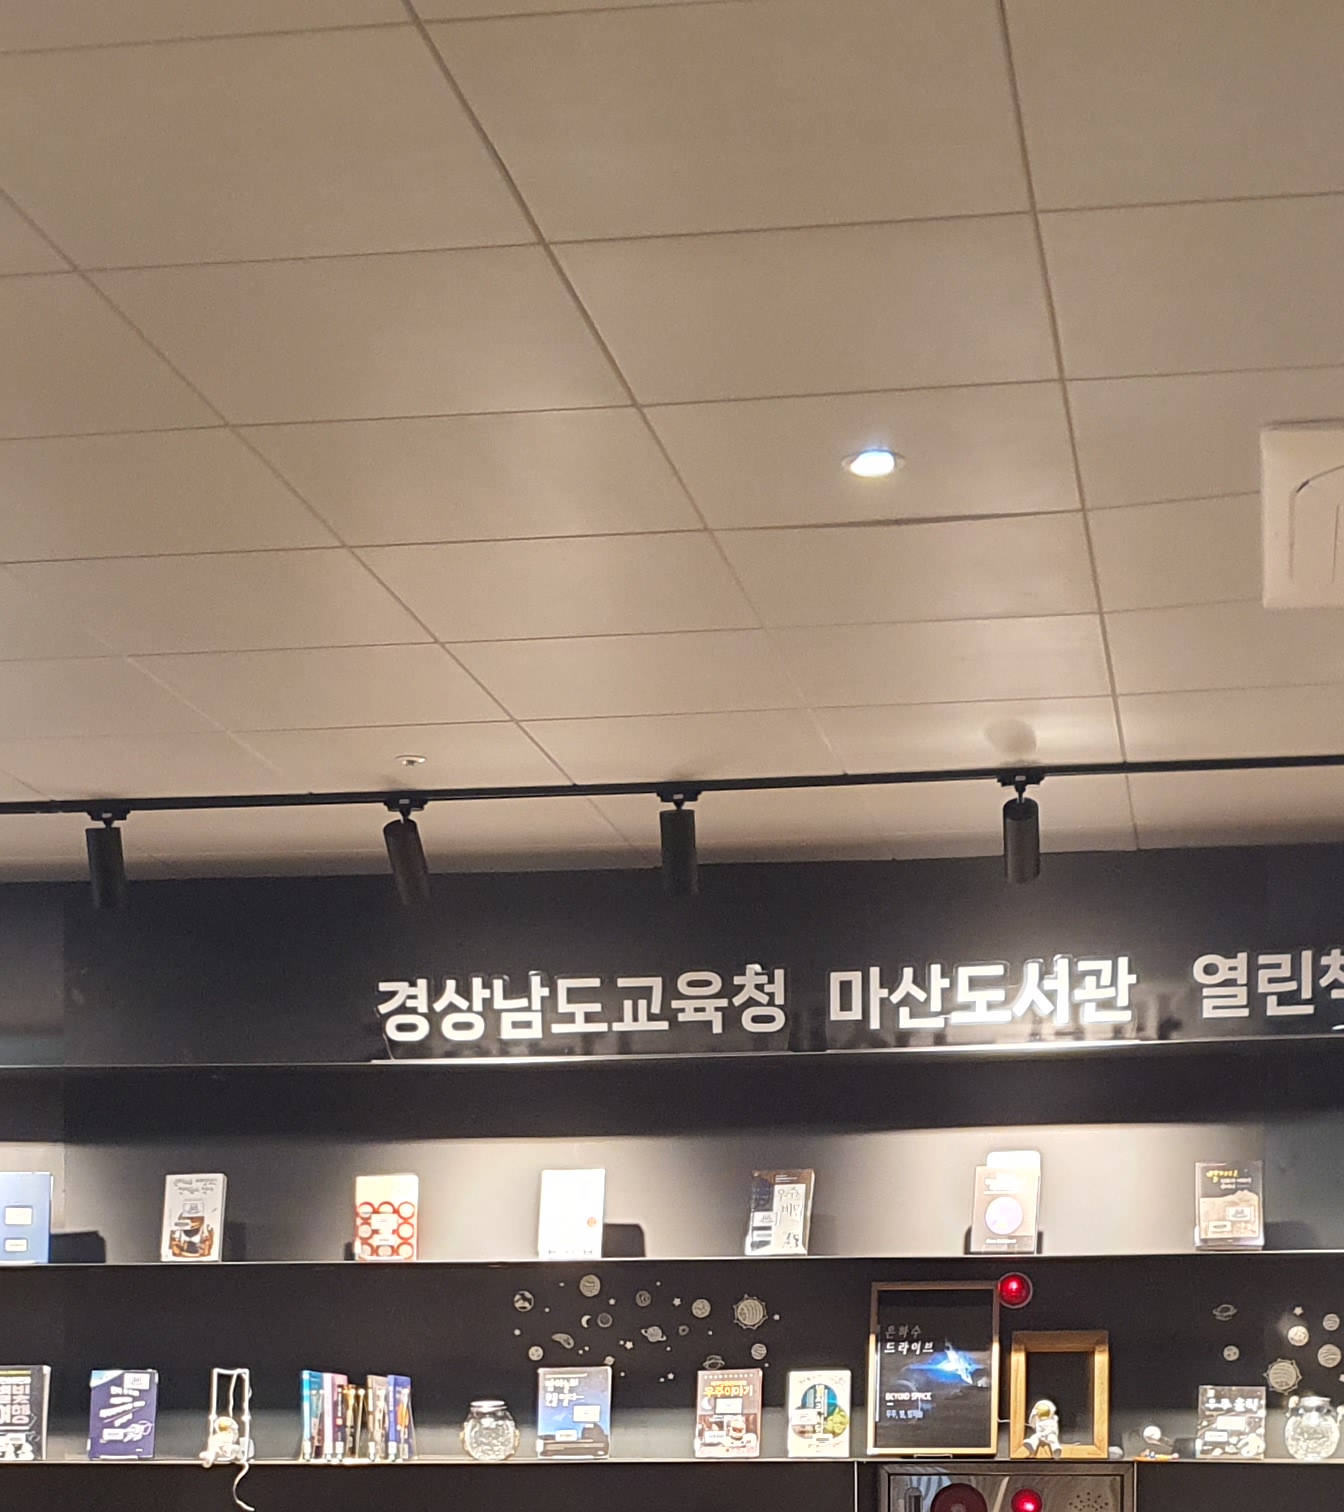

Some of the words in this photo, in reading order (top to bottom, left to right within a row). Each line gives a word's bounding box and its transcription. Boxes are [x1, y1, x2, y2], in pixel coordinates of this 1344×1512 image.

[376, 962, 787, 1042] 경상남도교육청
[829, 955, 1136, 1032] 마산도서관
[885, 1325, 921, 1339] 은하수
[884, 1341, 934, 1355] 드라이브
